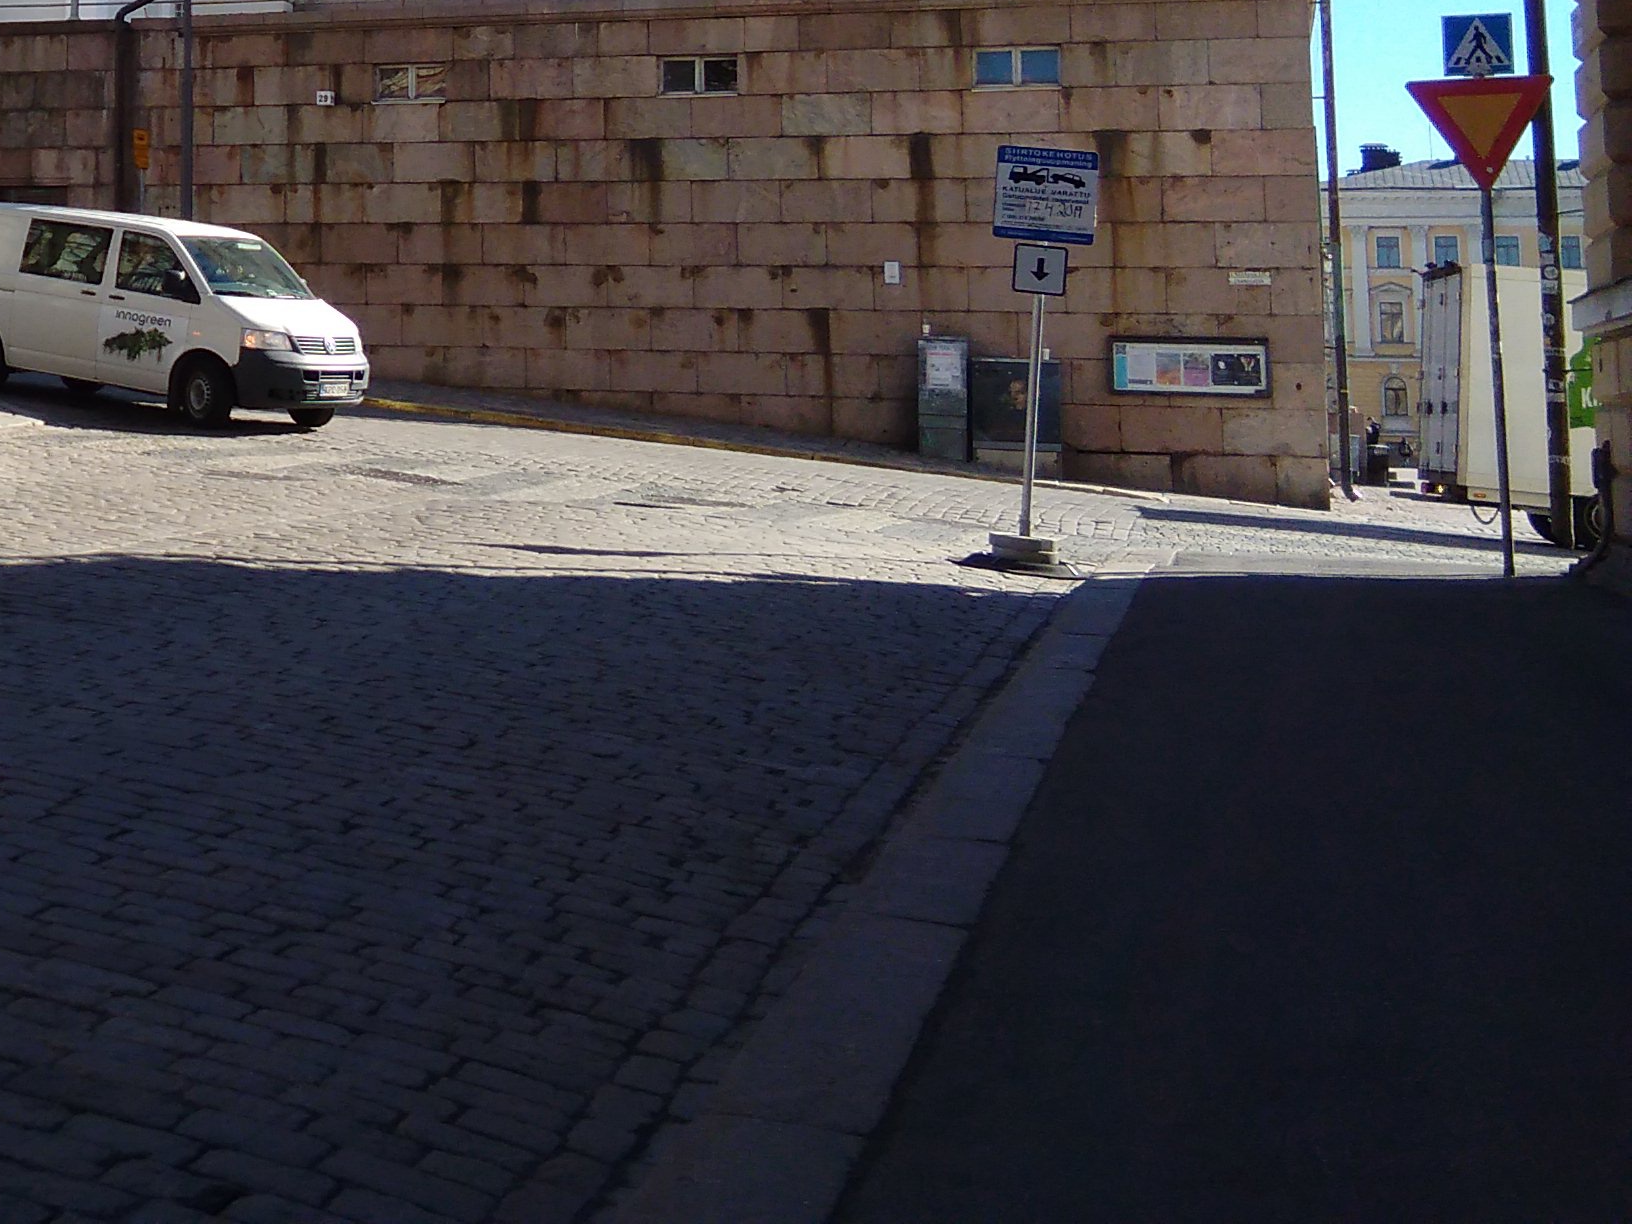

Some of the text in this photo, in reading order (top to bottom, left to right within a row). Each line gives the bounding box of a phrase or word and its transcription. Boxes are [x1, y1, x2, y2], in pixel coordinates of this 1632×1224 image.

[1004, 147, 1093, 161] SIIRTOKEHOTUS
[1002, 186, 1091, 198] KATUALUE VARATTU
[114, 309, 172, 327] innogreen
